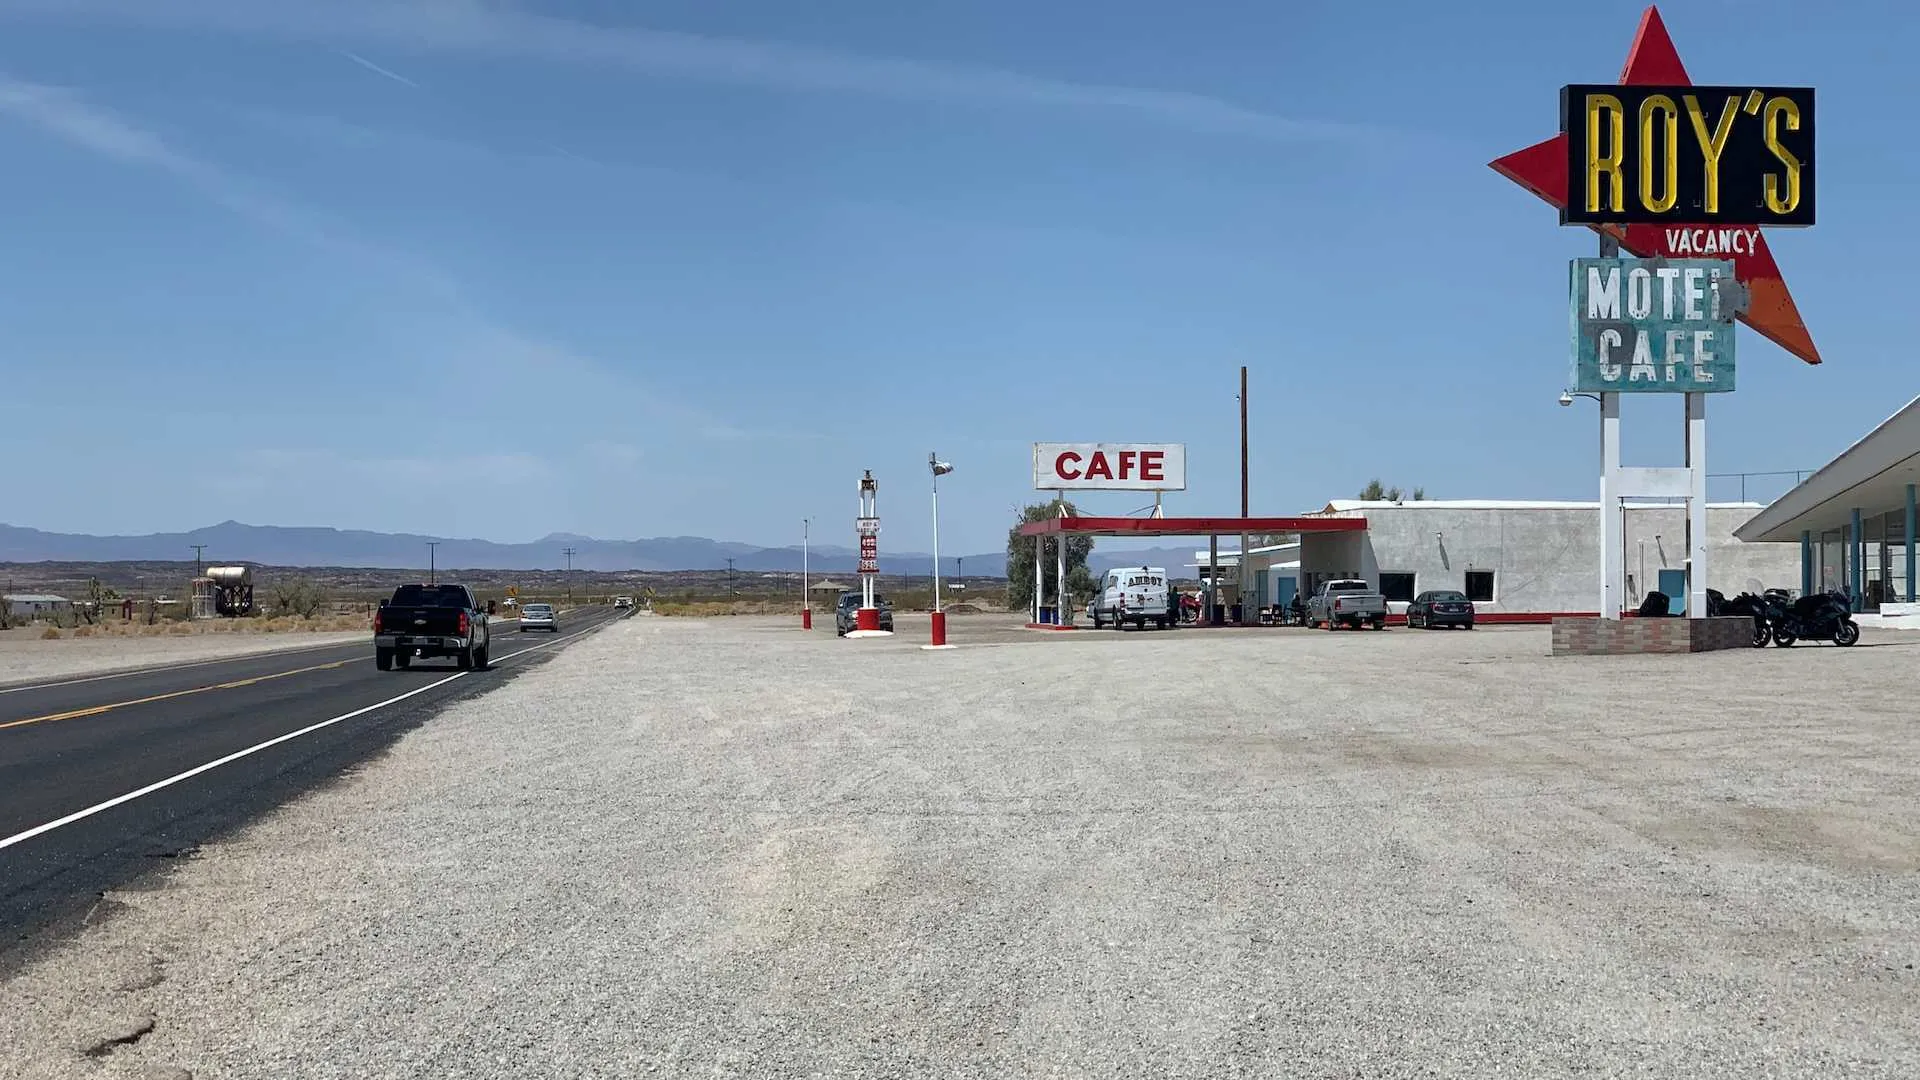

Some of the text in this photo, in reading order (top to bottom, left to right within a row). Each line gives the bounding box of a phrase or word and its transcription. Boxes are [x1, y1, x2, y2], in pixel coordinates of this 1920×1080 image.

[1585, 89, 1800, 214] ROY'S
[1665, 226, 1759, 256] VACANCY
[1599, 328, 1714, 382] CAFE
[1055, 451, 1164, 480] CAFE
